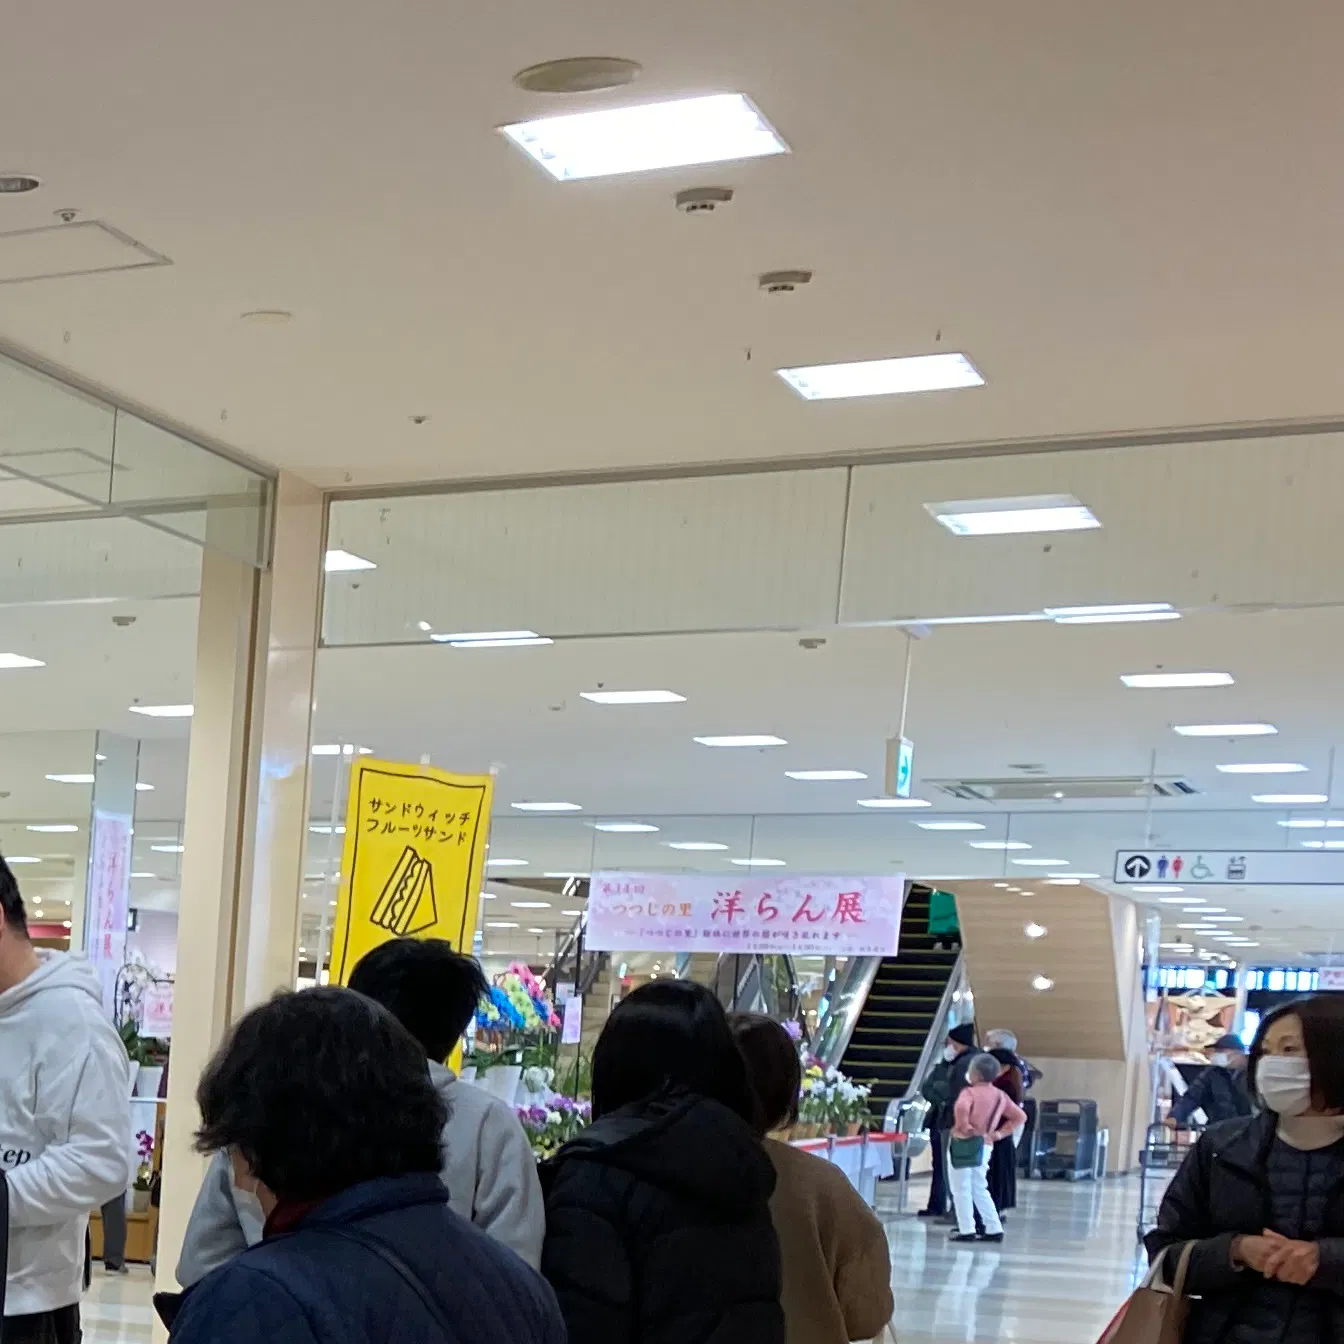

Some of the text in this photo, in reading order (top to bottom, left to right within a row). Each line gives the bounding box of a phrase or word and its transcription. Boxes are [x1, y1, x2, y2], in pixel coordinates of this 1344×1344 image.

[369, 797, 471, 826] サンドウィッチ
[367, 818, 467, 846] フルーツサンド
[612, 891, 868, 926] つつじの里 洋らん展
